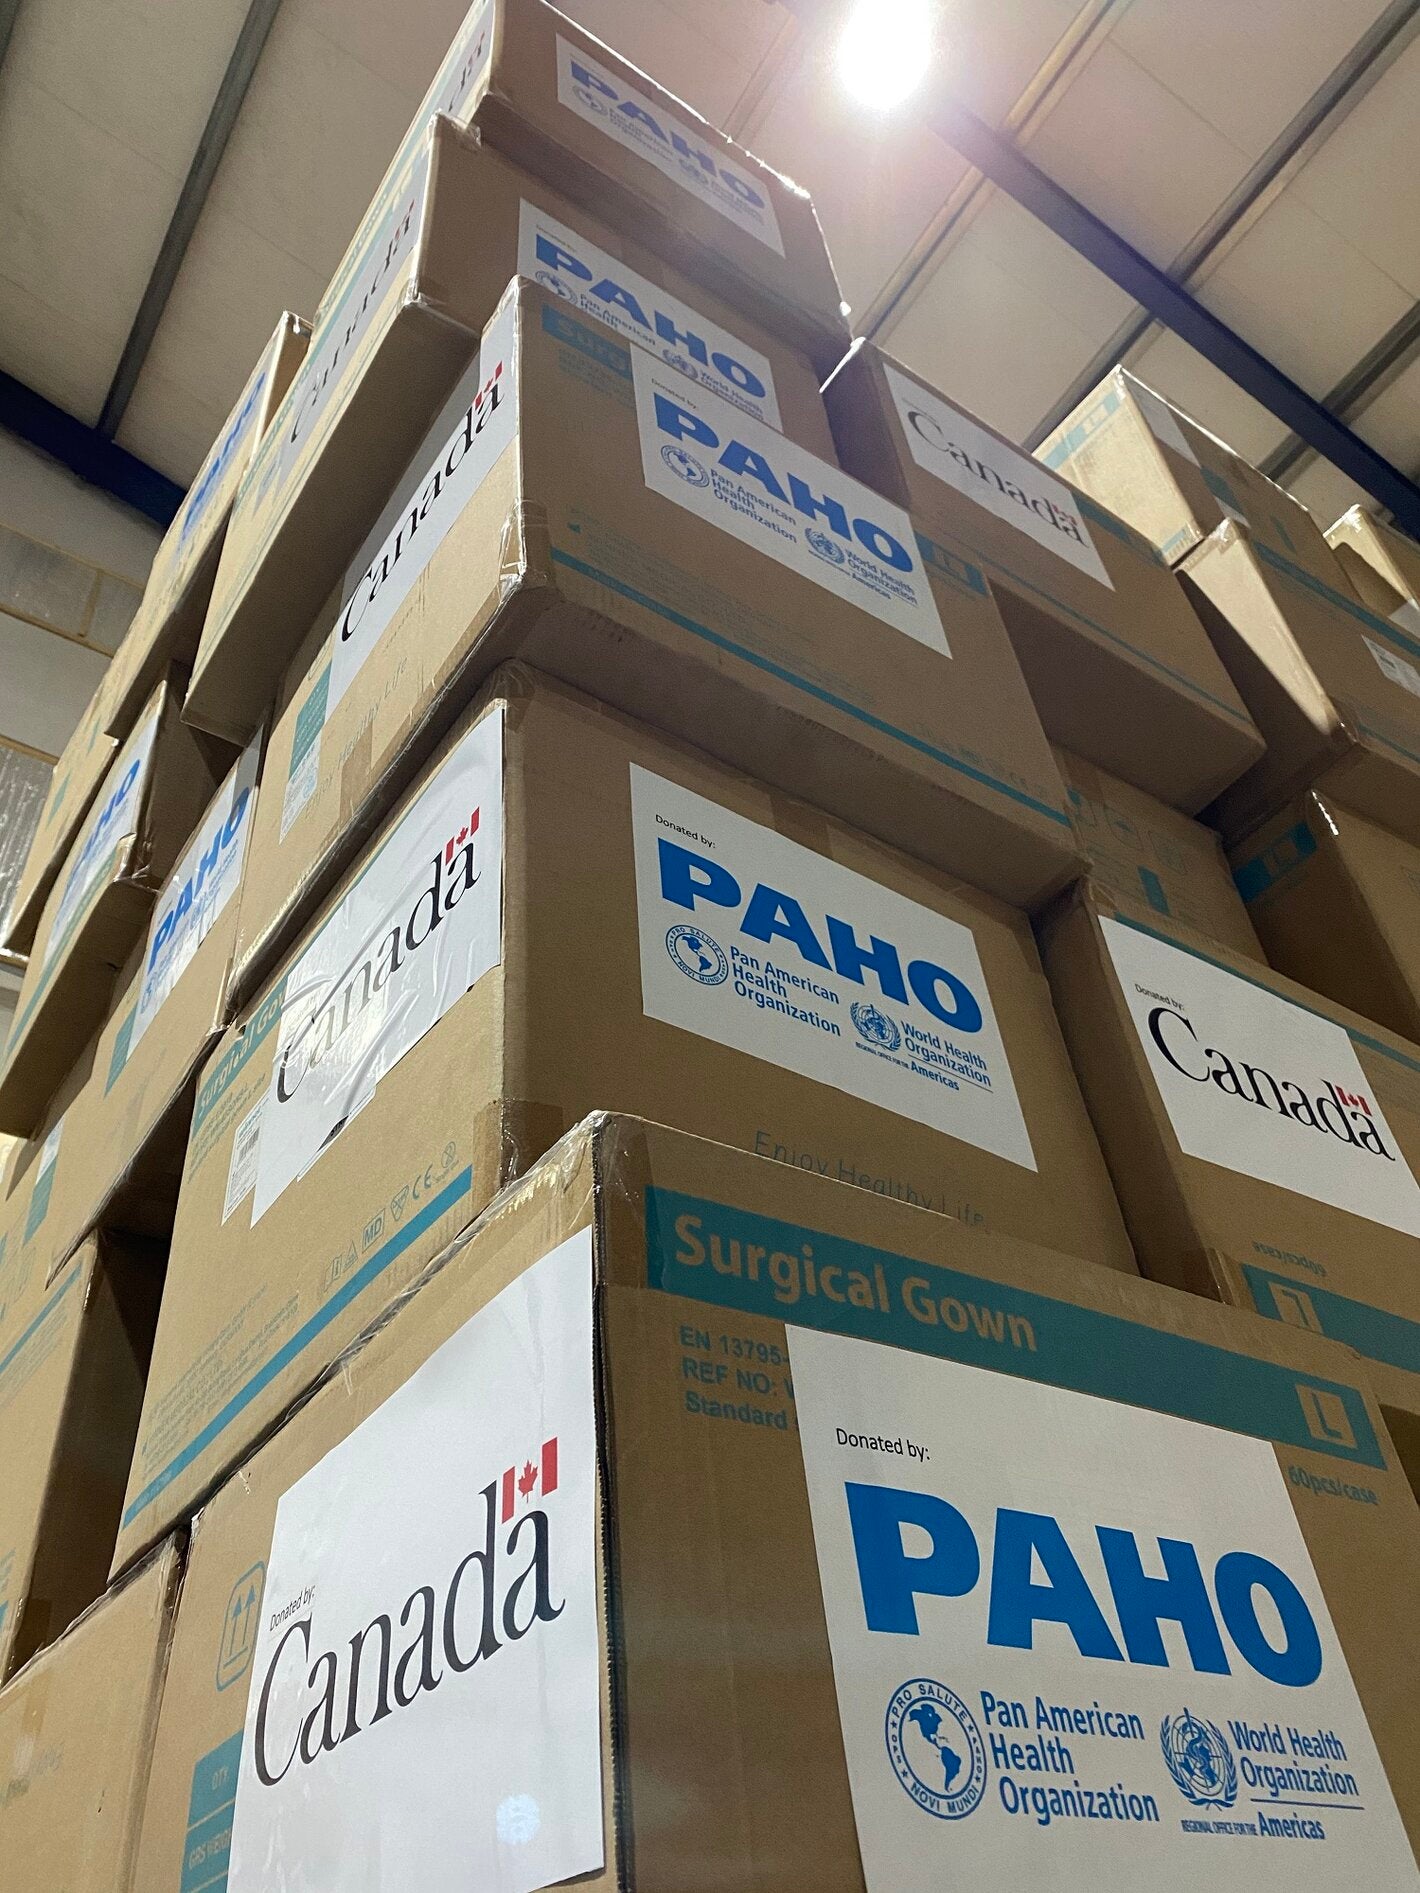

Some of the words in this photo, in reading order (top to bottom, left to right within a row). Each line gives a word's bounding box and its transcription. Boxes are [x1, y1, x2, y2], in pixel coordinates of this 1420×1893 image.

[570, 60, 765, 209] PAHO
[536, 233, 766, 399] PAHO
[653, 392, 913, 573] PAHO
[710, 468, 735, 489] Pan
[737, 485, 797, 526] American
[712, 478, 755, 510] Health
[907, 410, 1090, 548] Canada
[340, 380, 505, 643] Canada
[713, 488, 797, 543] Organization
[656, 814, 698, 840] Donated
[700, 834, 716, 849] by:
[147, 786, 251, 977] PAHO
[657, 837, 983, 1034] PAHO
[277, 842, 481, 1104] Canada
[730, 945, 760, 971] Pan
[764, 961, 840, 1005] American
[732, 962, 788, 998] Health
[1134, 983, 1171, 1005] Donated
[734, 980, 841, 1037] Organization
[901, 1020, 941, 1050] World
[944, 1040, 987, 1071] Health
[904, 1037, 992, 1087] Organization
[911, 1060, 960, 1091] Americas
[1147, 1006, 1396, 1162] Canada
[364, 1216, 383, 1246] MD
[673, 1214, 890, 1313] Surgical
[902, 1275, 1038, 1352] Gown
[679, 1324, 711, 1351] EN
[682, 1356, 728, 1385] REF
[685, 1390, 788, 1431] Standard
[1311, 1391, 1343, 1440] L
[836, 1427, 904, 1456] Donated
[905, 1438, 932, 1463] by:
[270, 1590, 303, 1632] Donated
[303, 1584, 316, 1605] by:
[845, 1481, 1323, 1688] PAHO
[254, 1479, 566, 1787] Canada
[891, 1688, 913, 1719] PRO
[918, 1683, 968, 1721] SALUTE
[980, 1690, 1028, 1730] Pan
[1035, 1695, 1145, 1741] American
[988, 1732, 1075, 1775] Health
[1227, 1719, 1287, 1756] World
[1286, 1726, 1348, 1762] Health
[910, 1781, 940, 1813] NOVI
[946, 1783, 980, 1814] MUNDI
[999, 1775, 1160, 1827] Organization
[1239, 1755, 1360, 1798] Organization
[1257, 1811, 1327, 1841] Americas
